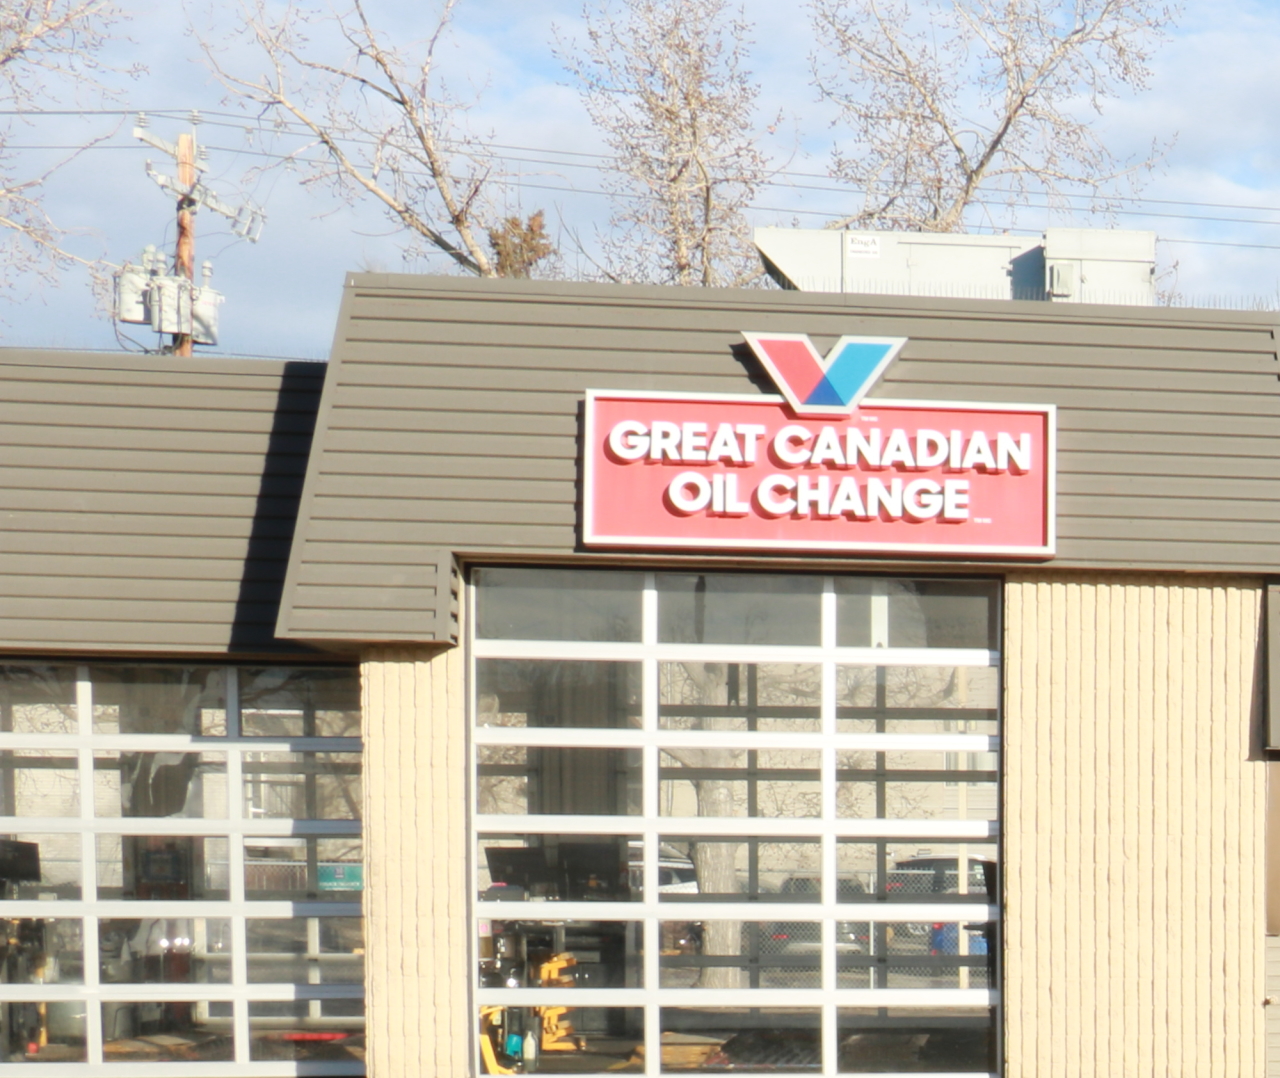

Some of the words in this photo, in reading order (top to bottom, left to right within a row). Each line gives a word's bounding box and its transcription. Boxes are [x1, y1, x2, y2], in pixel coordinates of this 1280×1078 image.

[608, 420, 766, 463] GREAT
[773, 425, 1031, 472] CANADIAN
[669, 471, 749, 514] OIL
[757, 477, 969, 520] CHANGE
